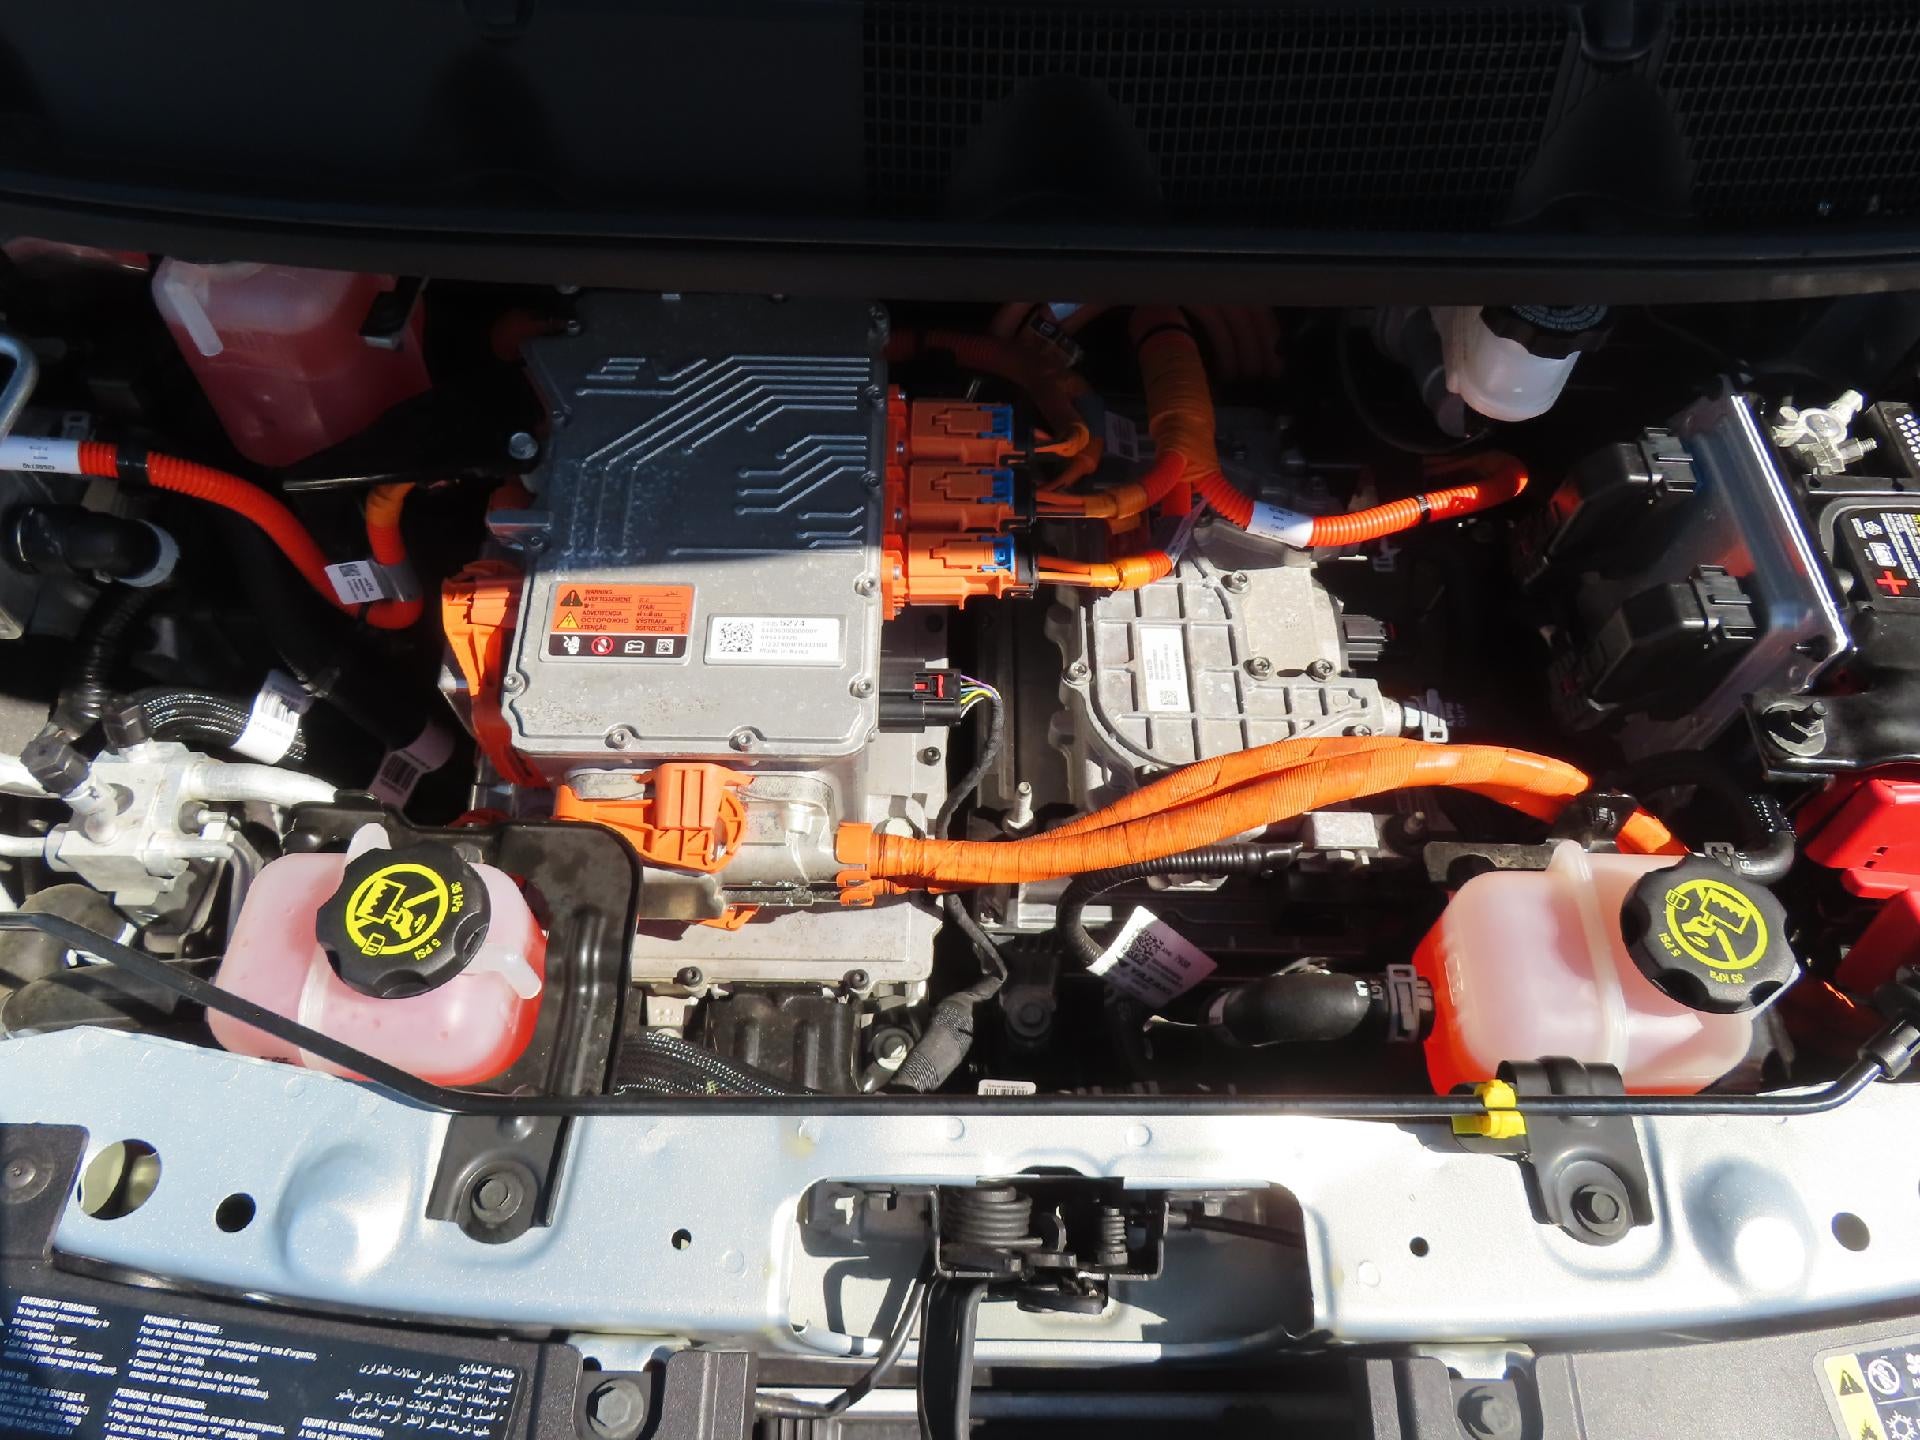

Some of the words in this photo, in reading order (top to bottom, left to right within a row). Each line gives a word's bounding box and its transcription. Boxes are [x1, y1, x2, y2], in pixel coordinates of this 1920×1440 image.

[451, 882, 462, 894] 35
[451, 895, 464, 912] kPa
[431, 938, 442, 948] 5
[1658, 932, 1674, 949] PSI
[414, 944, 433, 960] PSI
[1671, 949, 1681, 958] 5
[1710, 970, 1730, 984] kPa
[1731, 973, 1744, 984] 35
[21, 1295, 59, 1308] EMERGENCY
[60, 1302, 99, 1315] PERSONNEL:
[144, 1314, 181, 1328] PERSONNEL
